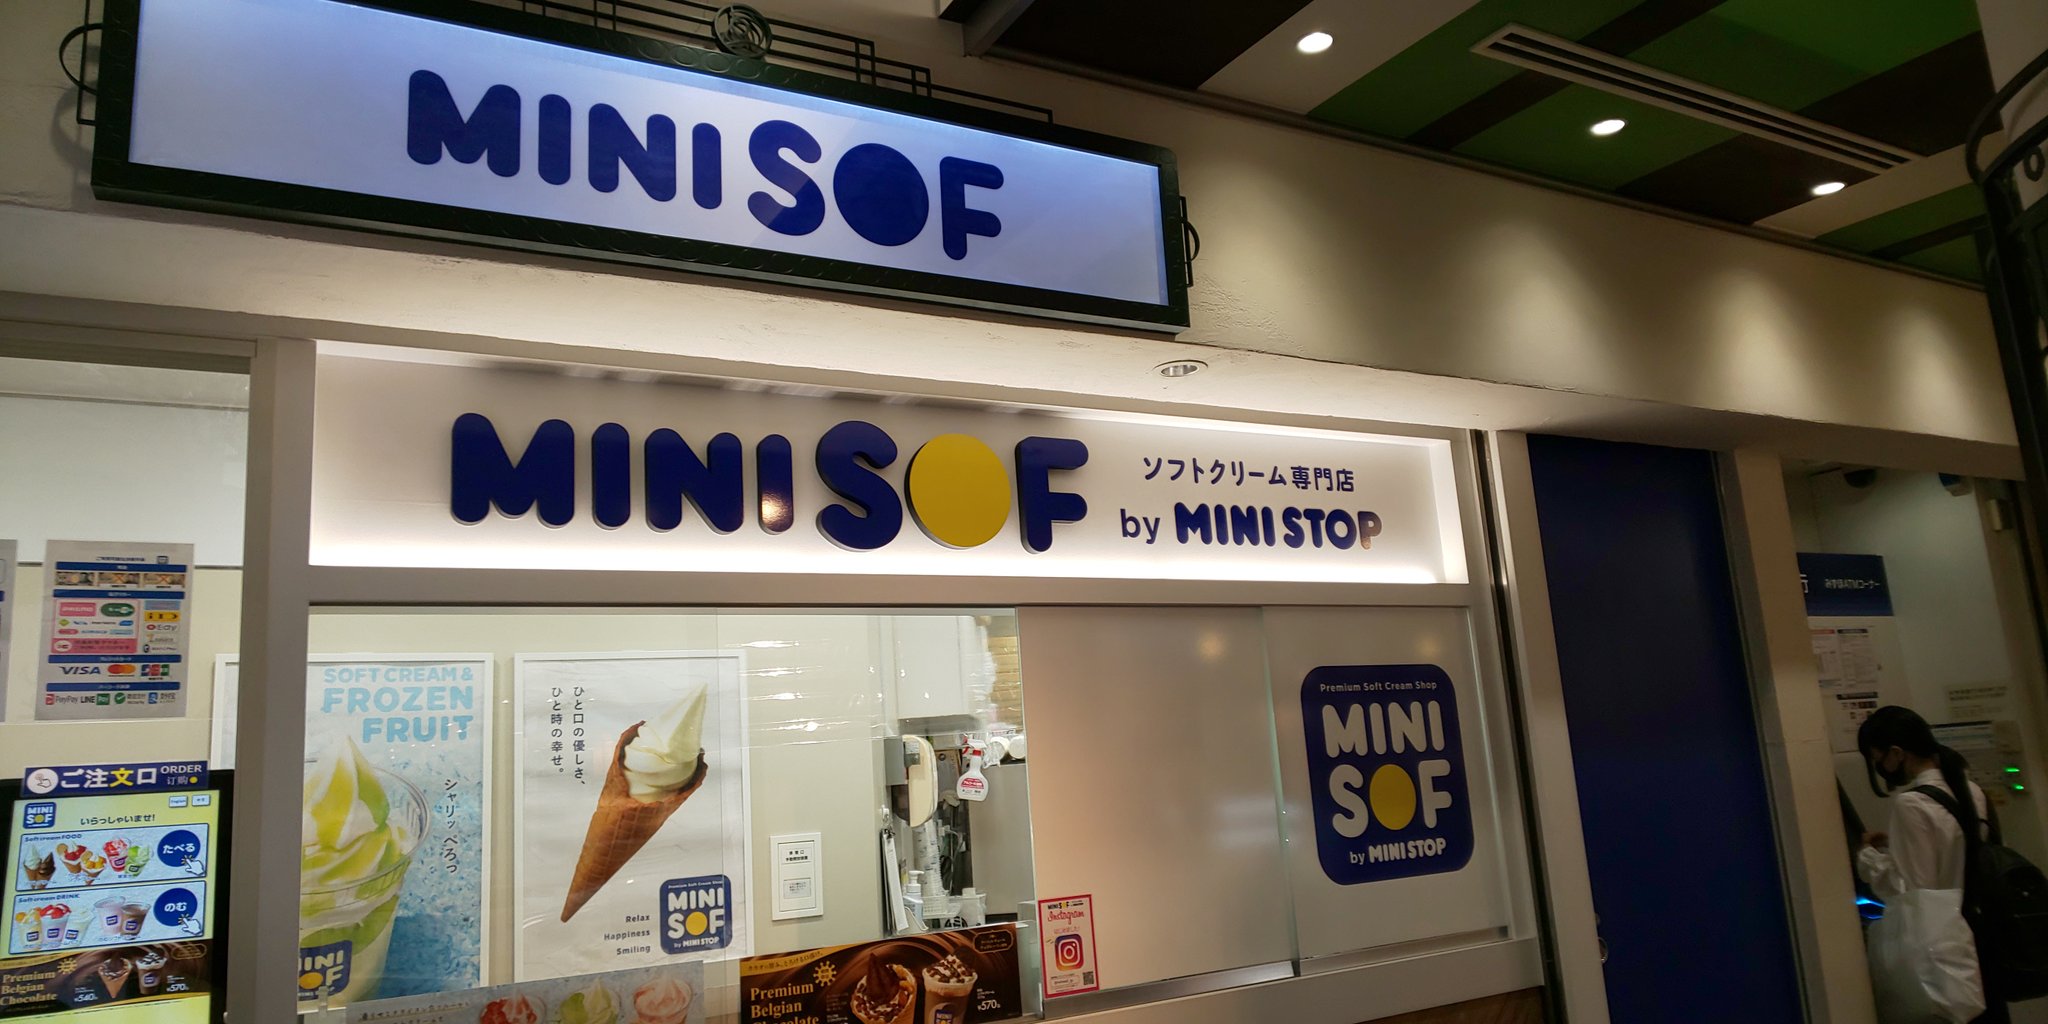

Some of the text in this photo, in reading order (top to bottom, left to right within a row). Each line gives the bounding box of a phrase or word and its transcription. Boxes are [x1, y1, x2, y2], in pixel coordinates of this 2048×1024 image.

[1143, 456, 1355, 492] ソフトクリーム専門店
[1119, 508, 1161, 545] by
[59, 666, 101, 675] VISA
[323, 666, 474, 684] SOFT CREAM &
[1320, 680, 1437, 692] Premium Soft Cream Shop
[80, 696, 95, 704] LINE
[321, 686, 474, 714] FROZEN
[362, 714, 474, 744] FRUIT
[1322, 700, 1445, 758] MINI
[60, 764, 203, 789] ご注文口 ORDER
[1328, 758, 1453, 838] SOF
[27, 805, 53, 815] MINI
[26, 814, 52, 824] SOF
[162, 843, 196, 854] たべる
[1350, 851, 1365, 865] by
[164, 901, 188, 912] のむ
[667, 887, 724, 912] MINI
[625, 913, 650, 923] Relax
[667, 908, 725, 939] SOF
[603, 928, 650, 941] Happiness
[616, 943, 651, 956] Smiling
[299, 950, 344, 972] INI
[3, 971, 56, 984] Premium
[298, 965, 345, 990] OF
[1, 983, 45, 995] Belgian
[750, 983, 814, 1001] Premium
[0, 992, 58, 1006] Chocolate
[751, 1001, 802, 1019] Belgian
